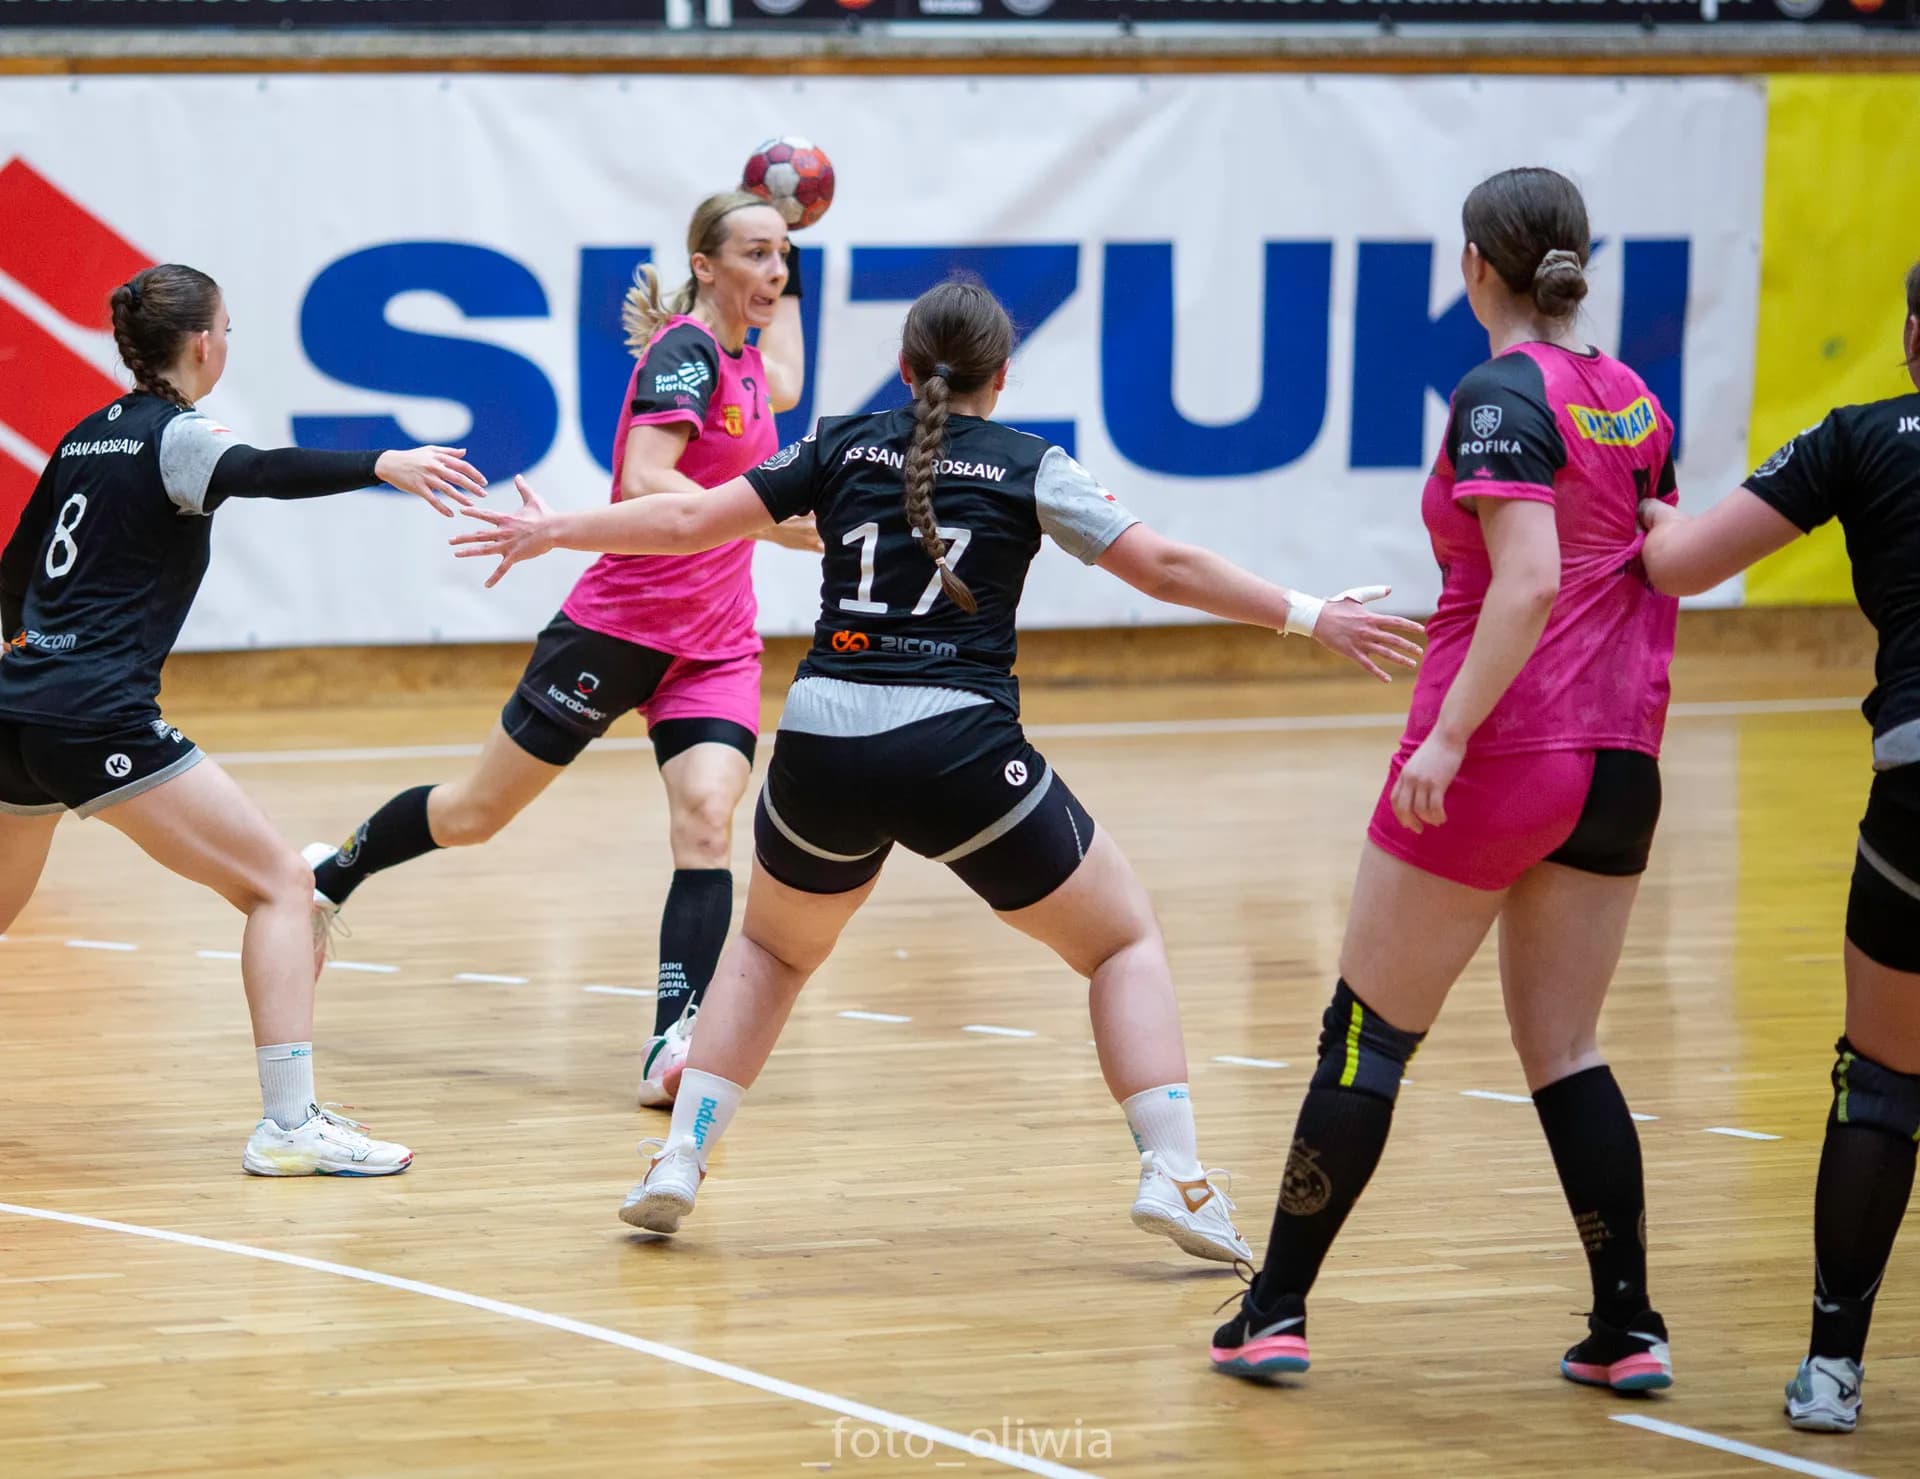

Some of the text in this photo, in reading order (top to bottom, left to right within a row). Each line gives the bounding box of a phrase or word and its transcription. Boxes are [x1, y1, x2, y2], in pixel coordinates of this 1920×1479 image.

[655, 374, 678, 384] Sun
[1897, 417, 1920, 433] JK
[1459, 439, 1523, 457] ROFIKA
[865, 446, 905, 470] SAN
[930, 459, 1007, 483] ROSŁAW
[45, 492, 88, 580] 8
[838, 521, 973, 616] 17
[660, 962, 683, 972] ZUKI
[659, 971, 687, 981] RONA
[658, 980, 691, 990] DBALL
[658, 989, 681, 999] ELCE
[694, 1096, 717, 1151] empa
